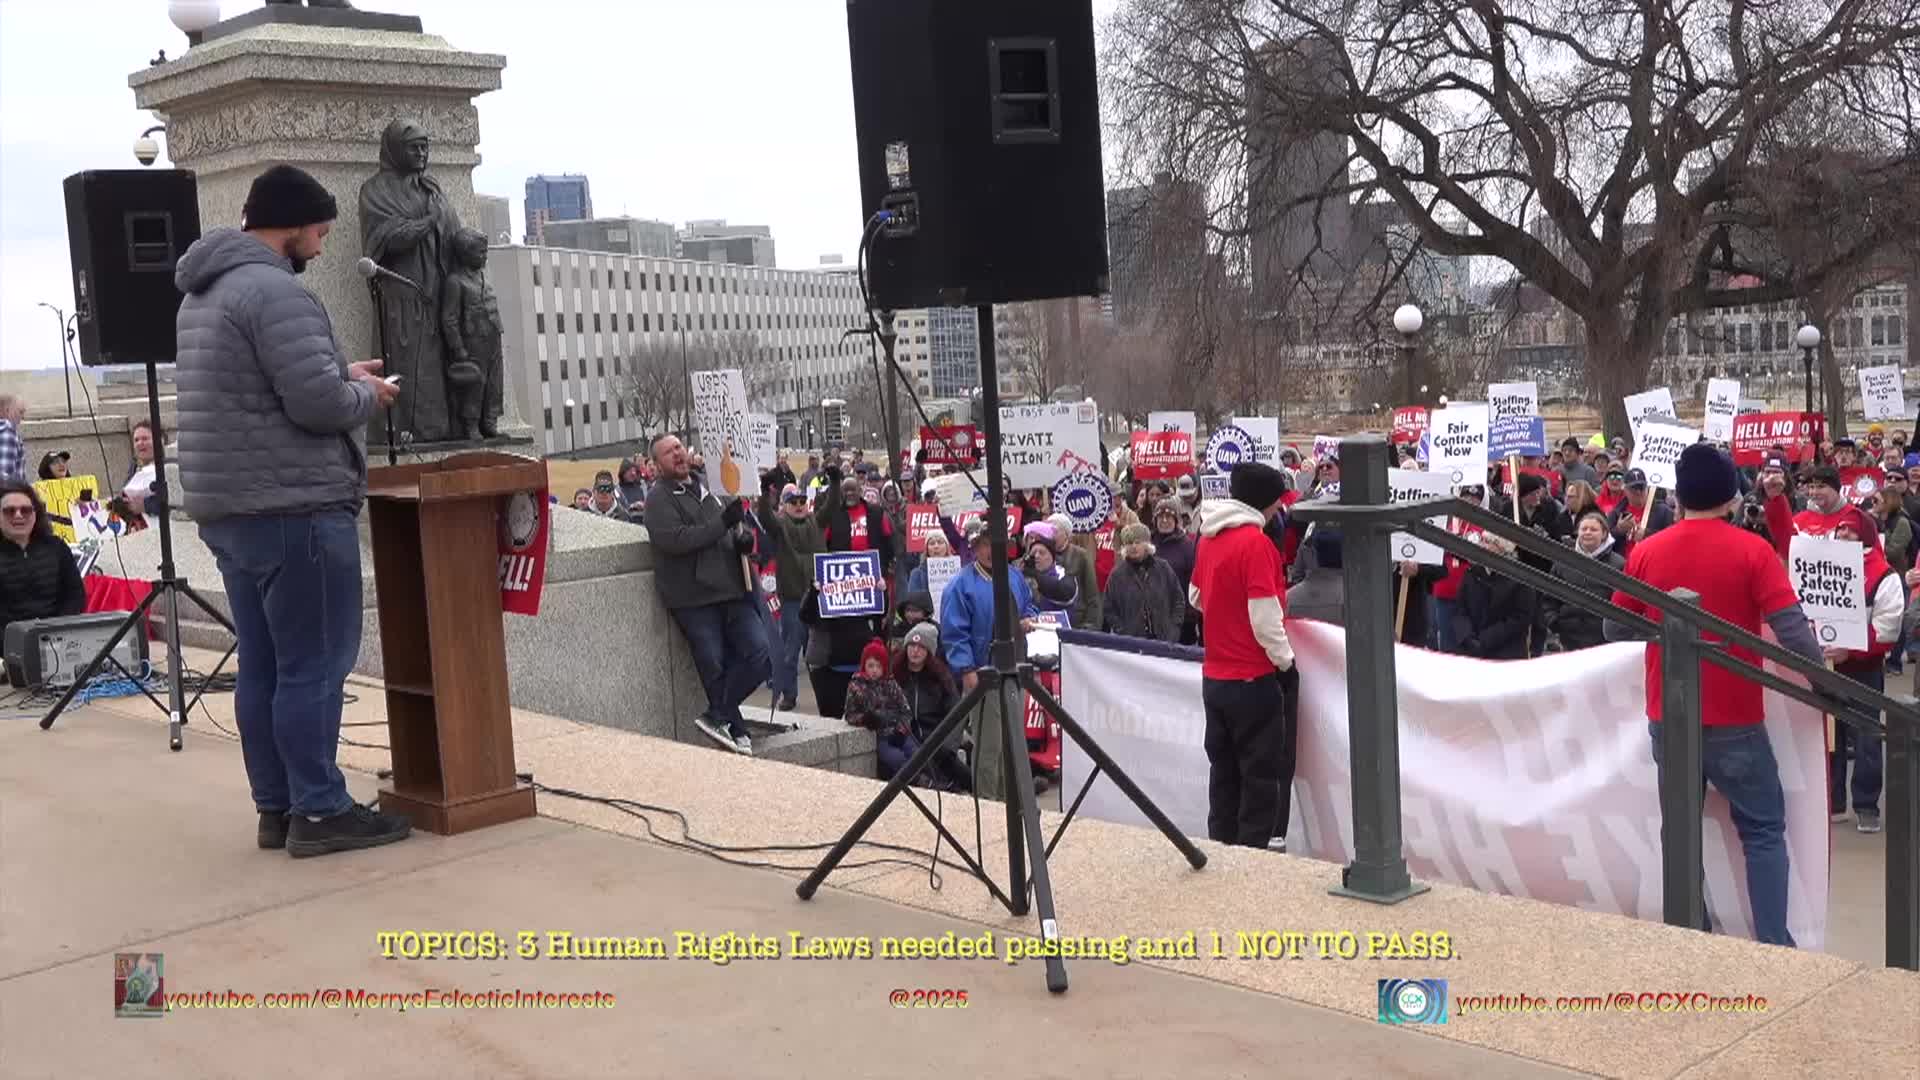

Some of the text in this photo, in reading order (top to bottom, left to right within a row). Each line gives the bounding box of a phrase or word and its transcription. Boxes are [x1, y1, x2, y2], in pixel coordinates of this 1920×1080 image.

[698, 373, 729, 395] USPS
[1493, 395, 1533, 406] Staffing.
[1001, 409, 1015, 419] US
[1021, 408, 1043, 417] POST
[1497, 405, 1529, 415] Safety.
[698, 415, 744, 436] DELIVERY
[1448, 422, 1469, 434] Fair
[1736, 422, 1767, 439] HELL
[1771, 420, 1794, 436] NO
[1000, 432, 1053, 447] RIVATI
[1169, 439, 1188, 454] NO
[1434, 433, 1483, 447] Contract
[1003, 450, 1052, 464] ATION?
[1218, 450, 1239, 464] UAW
[1444, 447, 1471, 458] Now
[1388, 487, 1440, 504] Staffin
[1067, 495, 1093, 512] UAW
[911, 512, 942, 528] HELL
[498, 554, 535, 592] ELL!
[1795, 557, 1857, 581] Staffing.
[1800, 573, 1853, 596] Safety.
[832, 591, 870, 606] MAIL
[1798, 588, 1857, 609] Service.
